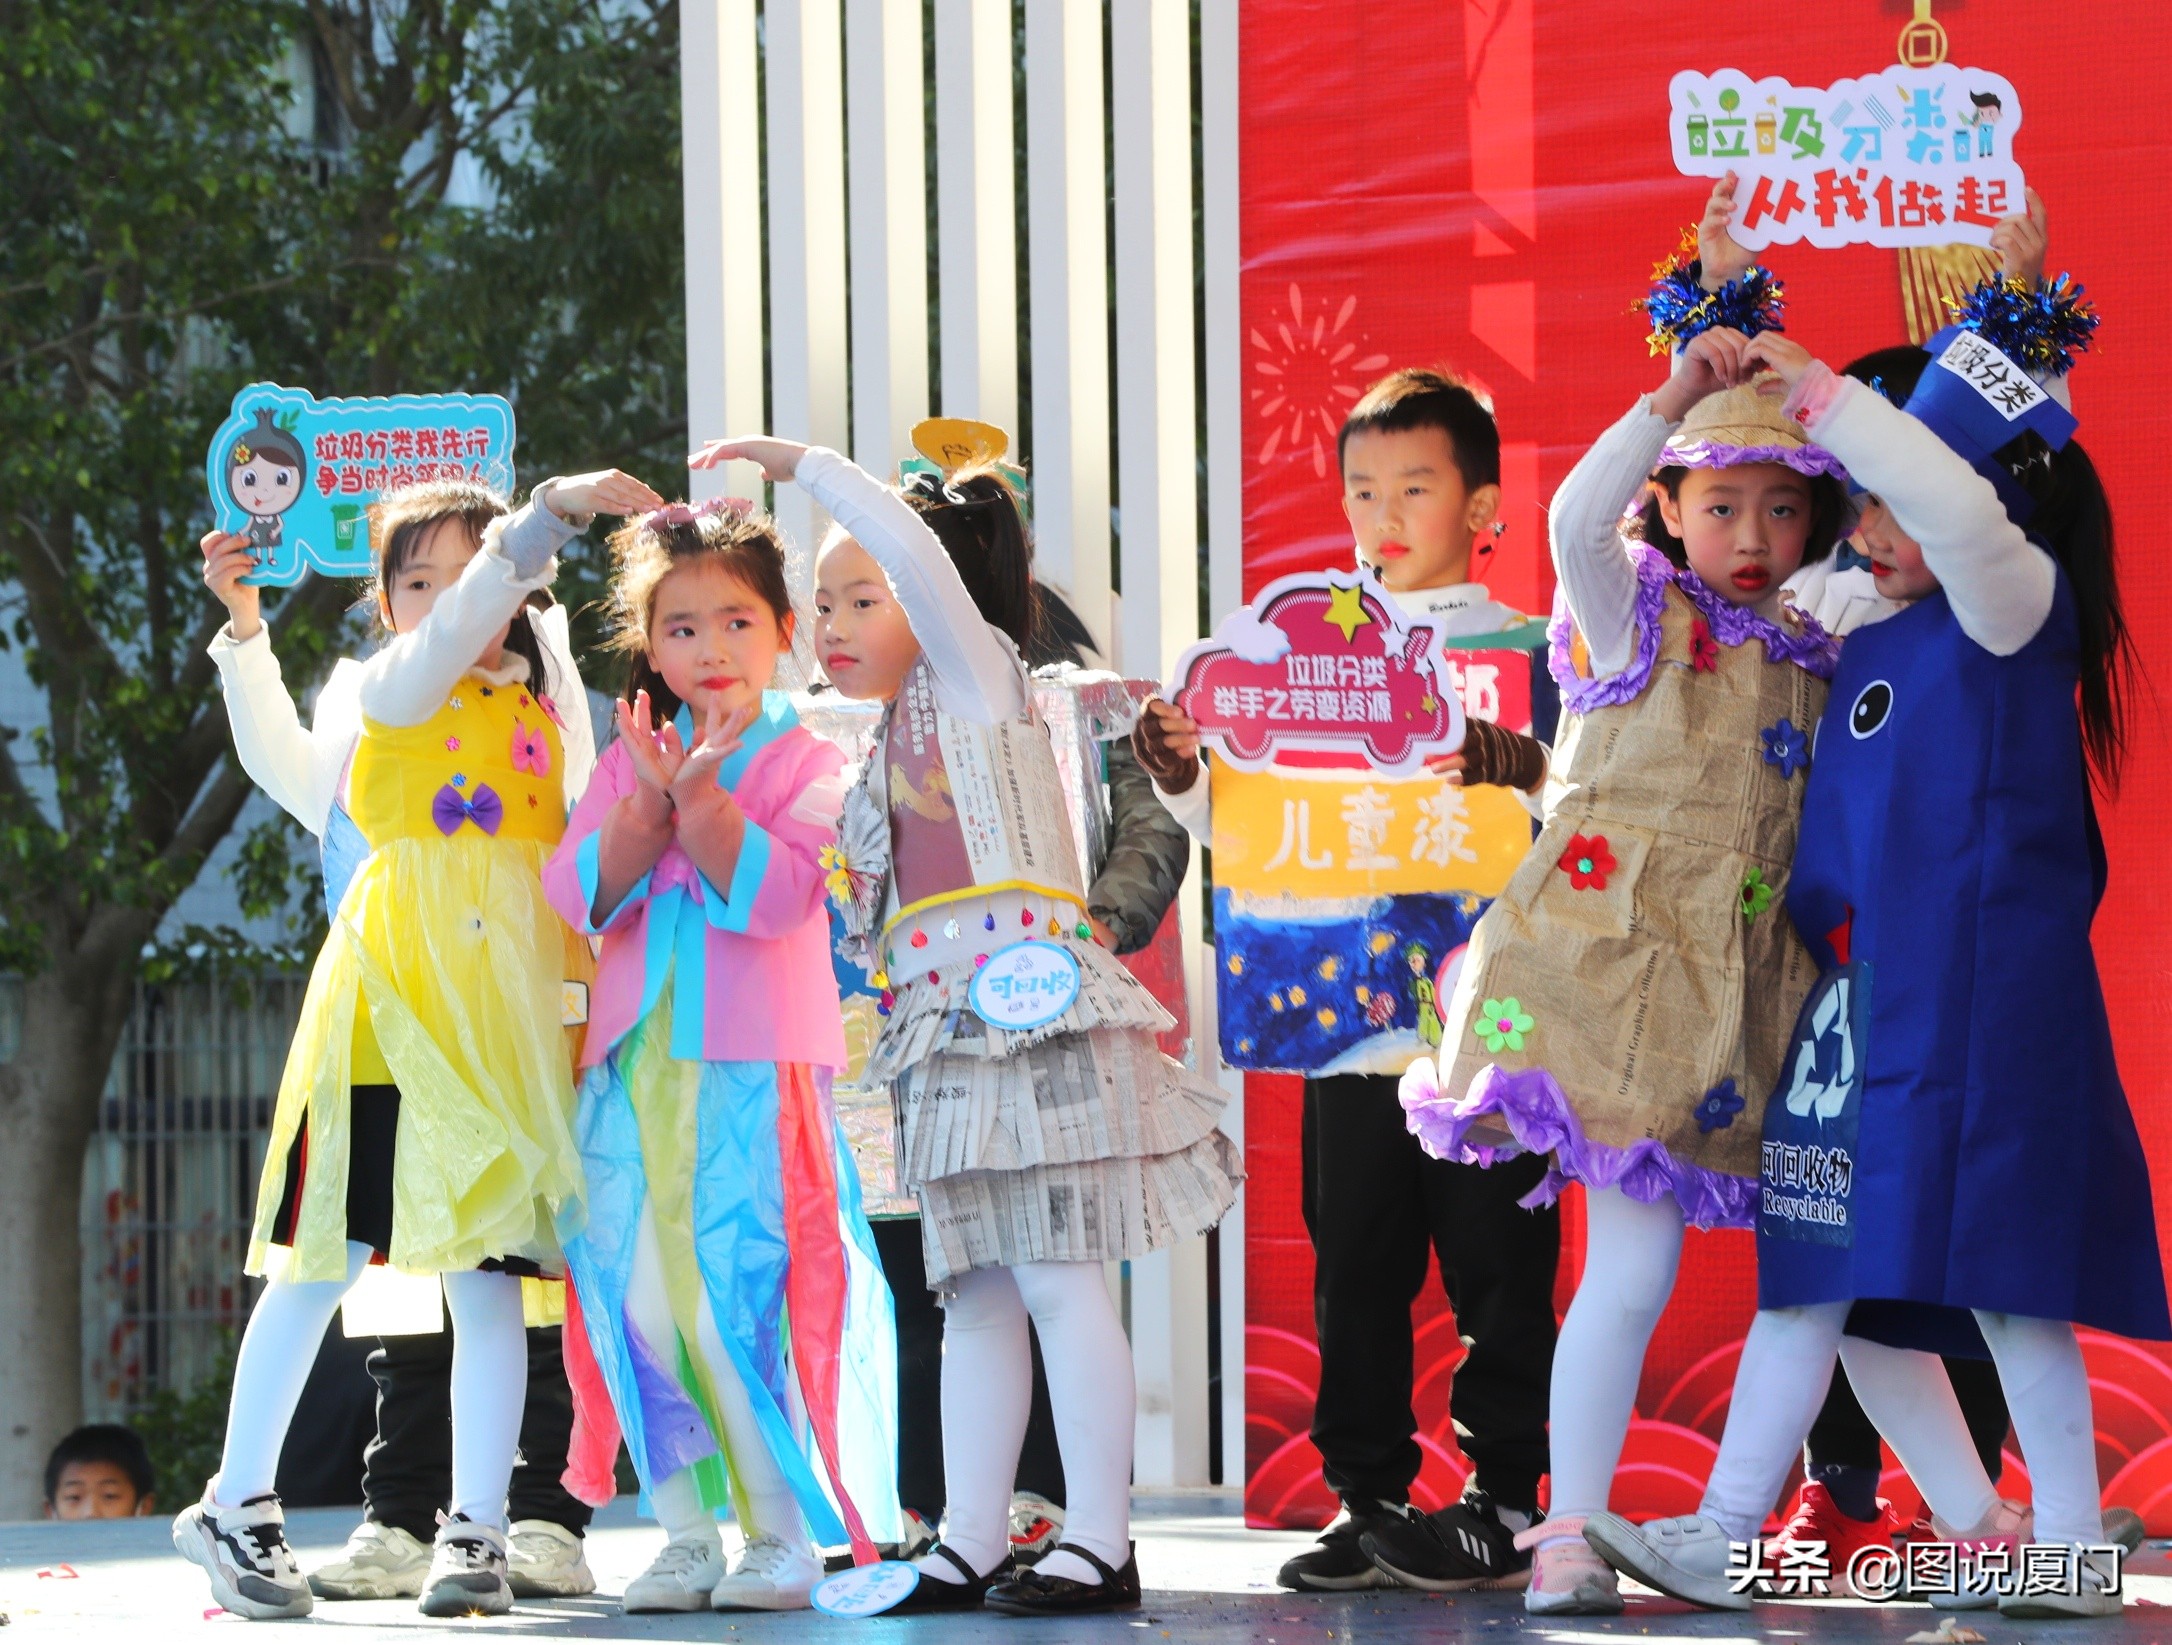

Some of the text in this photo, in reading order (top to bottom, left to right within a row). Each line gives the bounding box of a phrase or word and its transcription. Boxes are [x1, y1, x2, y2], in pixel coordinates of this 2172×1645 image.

[1686, 84, 1945, 164] 垃圾分类
[1743, 168, 2009, 229] 从我做起
[315, 428, 490, 461] 垃圾分类我先行
[1285, 653, 1388, 688] 垃圾分类
[1263, 785, 1478, 872] 儿童漆
[988, 969, 1073, 999] 可回收
[1618, 1052, 1636, 1096] Original
[1628, 1002, 1649, 1050] Graphing
[1762, 1140, 1853, 1198] 可回收物
[1763, 1187, 1847, 1227] Recyclable
